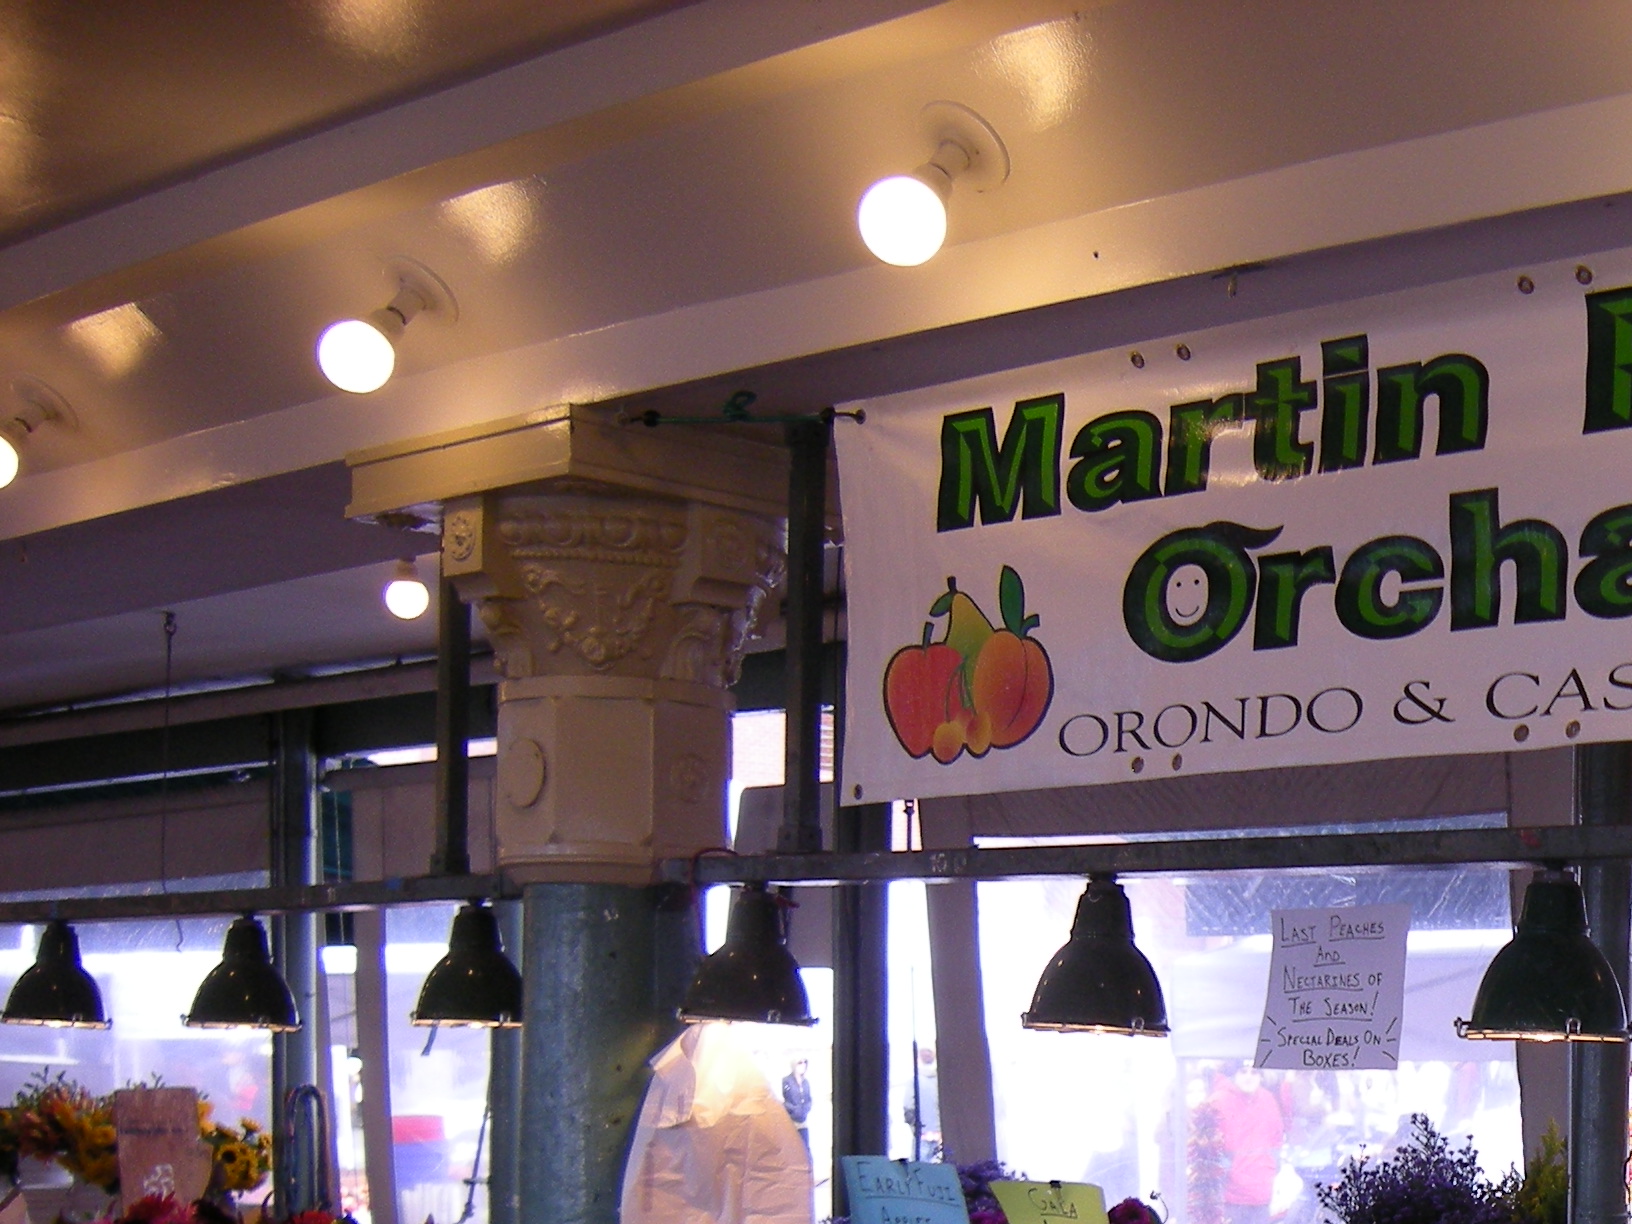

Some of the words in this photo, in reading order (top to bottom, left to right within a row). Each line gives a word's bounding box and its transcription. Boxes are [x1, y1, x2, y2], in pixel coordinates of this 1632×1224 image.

[936, 334, 1492, 533] Martin
[1060, 685, 1363, 758] ORONDO
[1394, 679, 1450, 724] &
[1281, 917, 1316, 942] LAST
[1329, 915, 1385, 938] PEACHES
[1284, 966, 1360, 989] NECTARINES
[1368, 973, 1382, 986] OF
[1288, 998, 1312, 1015] THE
[1277, 1027, 1322, 1047] SPECIAL
[1327, 1027, 1359, 1046] DEALS
[1364, 1030, 1381, 1045] ON
